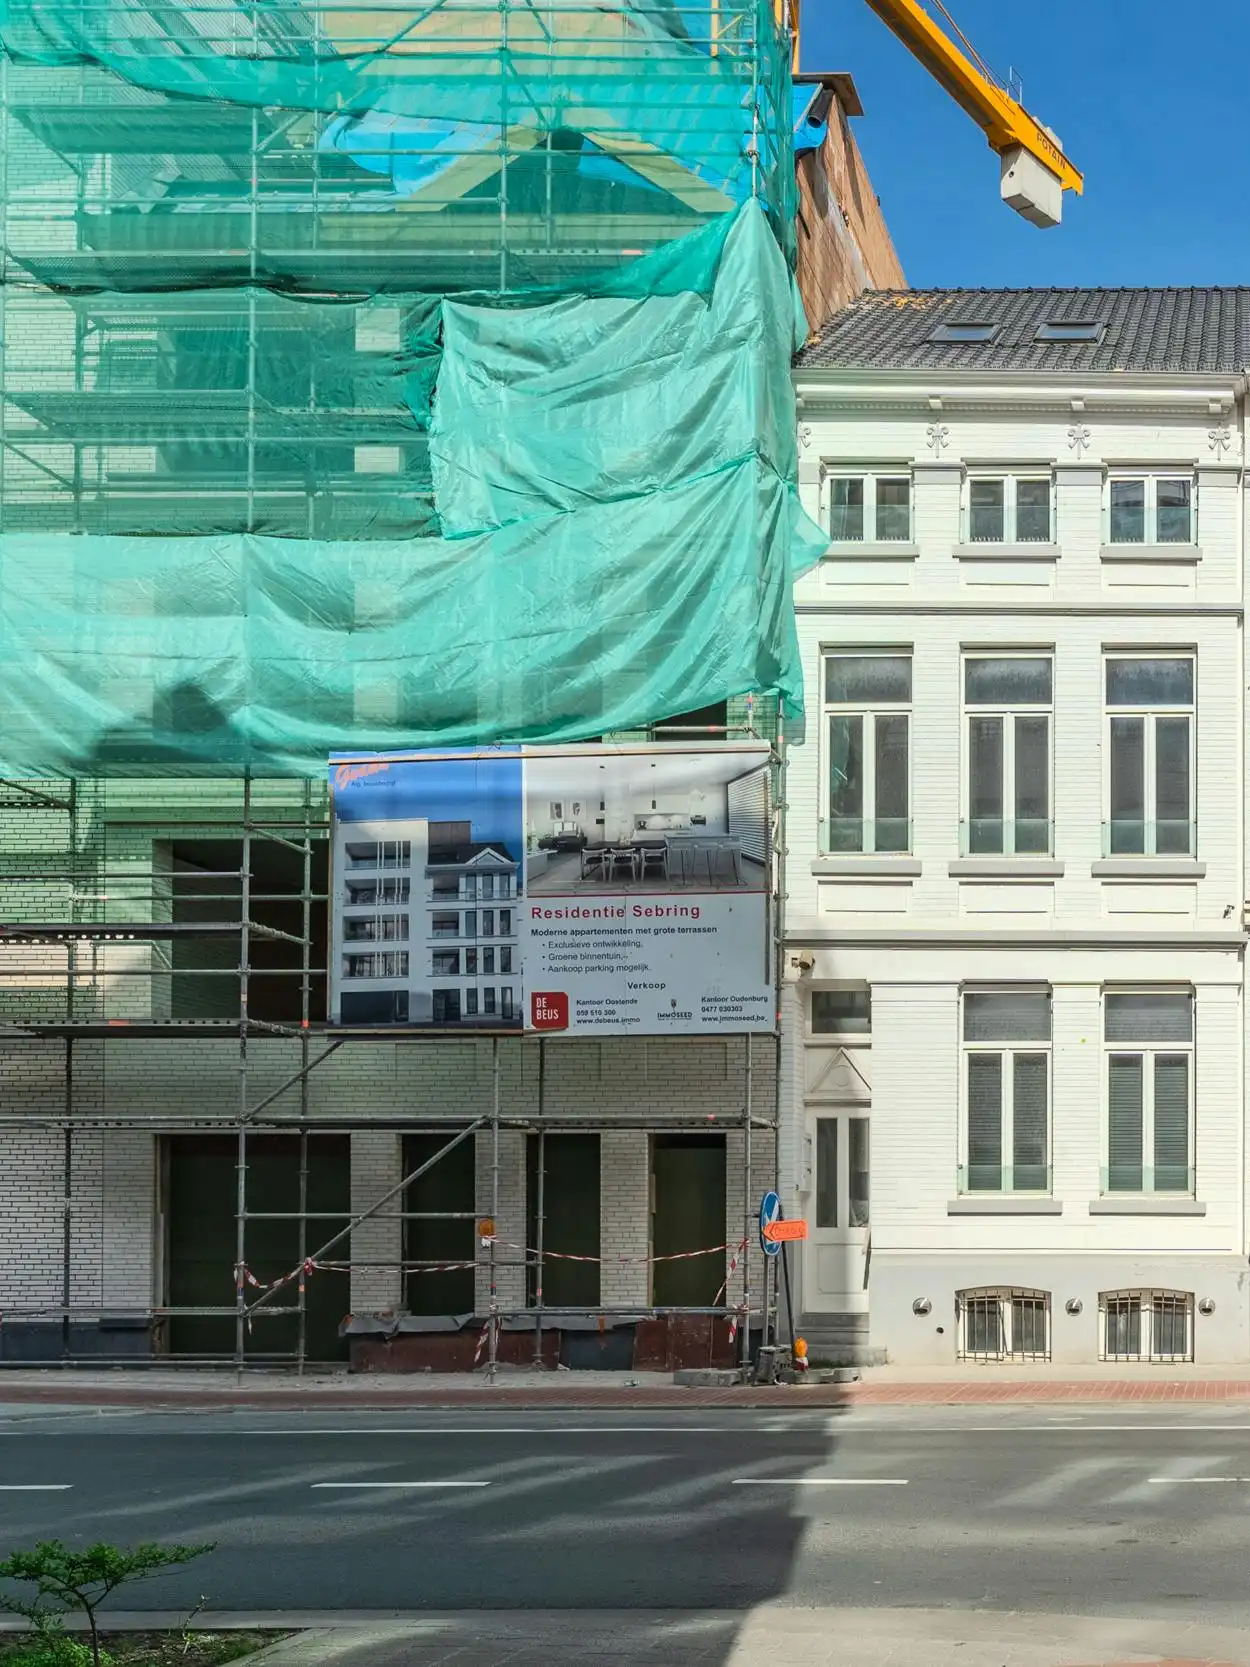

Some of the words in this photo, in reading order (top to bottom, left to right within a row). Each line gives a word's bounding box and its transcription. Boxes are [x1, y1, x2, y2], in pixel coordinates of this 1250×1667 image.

[1036, 131, 1066, 169] POTAIN
[531, 906, 625, 919] Residentie
[632, 905, 700, 919] Sebring
[531, 928, 568, 936] Moderne
[570, 927, 633, 936] appartementen
[635, 927, 651, 935] met
[653, 927, 675, 935] grote
[677, 926, 717, 934] terrassen
[548, 953, 578, 961] Groene
[548, 965, 583, 973] Aankoop
[584, 964, 614, 973] parking
[627, 982, 666, 990] Verkoop
[536, 997, 547, 1008] DE
[730, 995, 768, 1003] Oudenburg
[536, 1009, 559, 1020] BEUS
